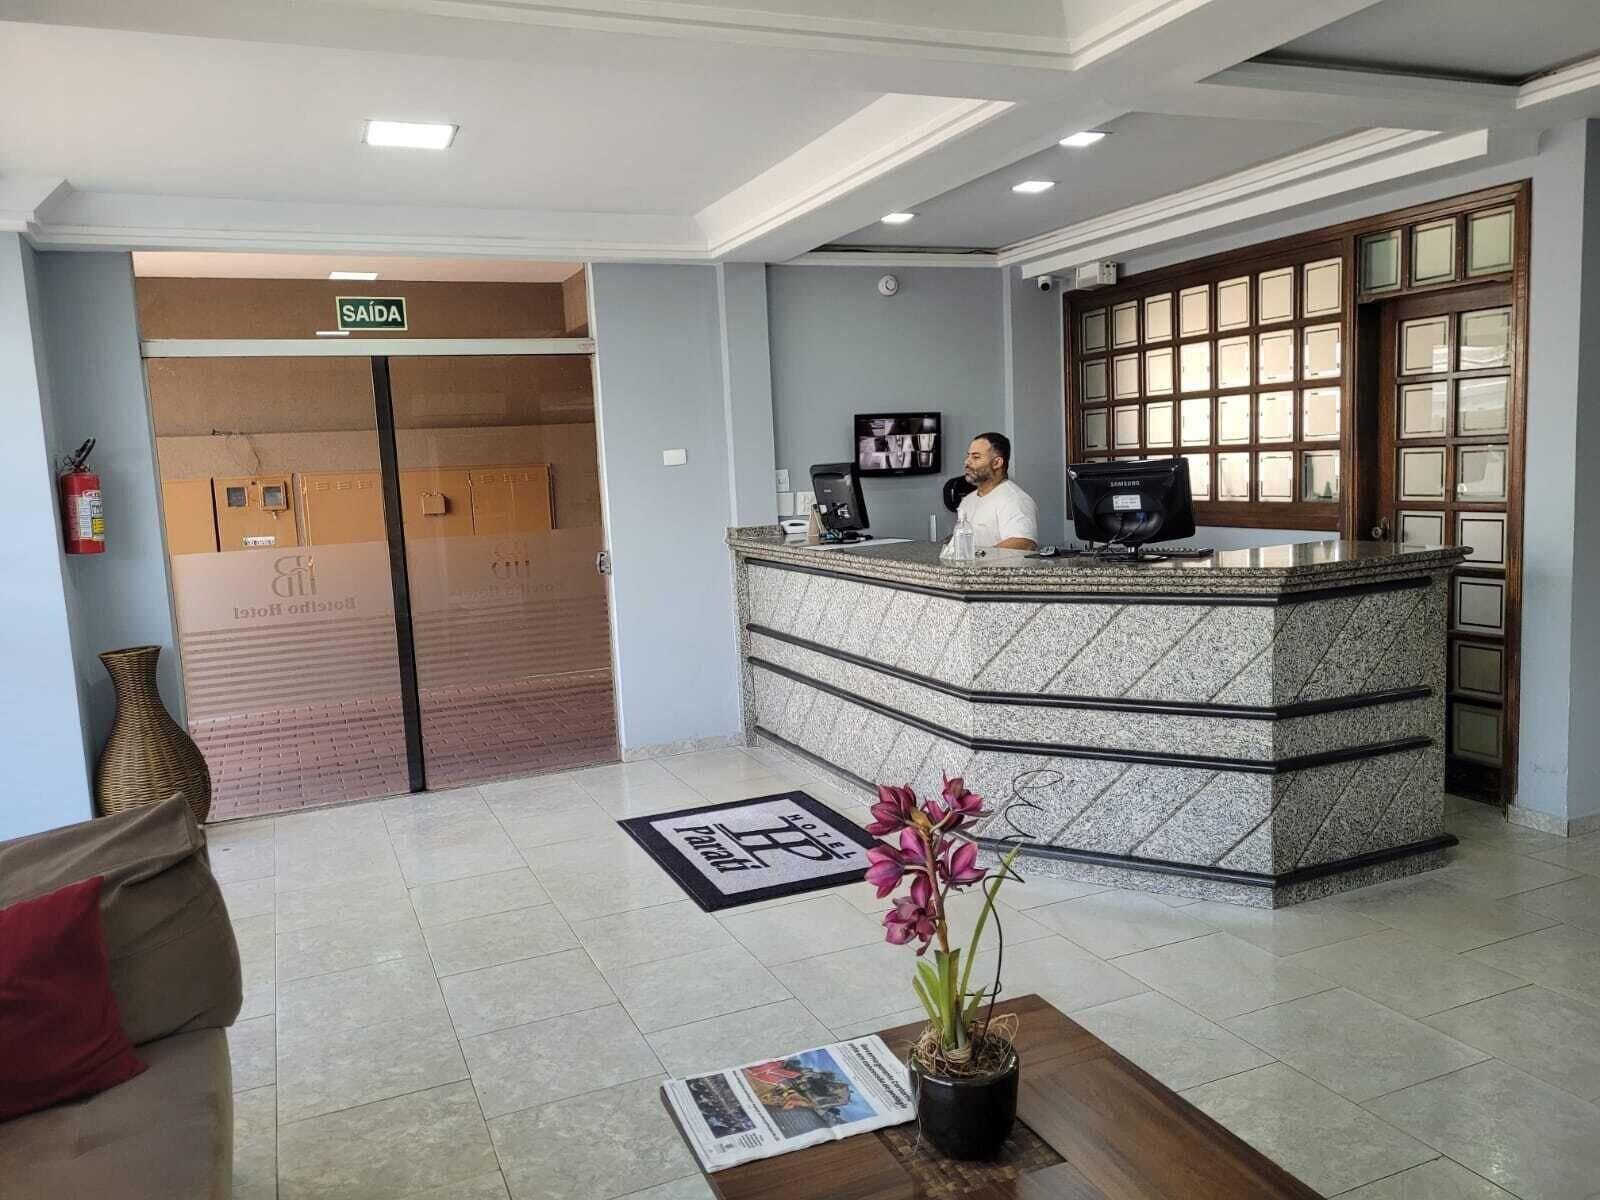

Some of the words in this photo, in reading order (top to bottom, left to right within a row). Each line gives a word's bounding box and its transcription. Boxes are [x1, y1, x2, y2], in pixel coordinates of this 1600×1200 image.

[342, 300, 402, 322] SAÍDA
[672, 824, 762, 874] Parati
[786, 813, 858, 860] HOTEL
